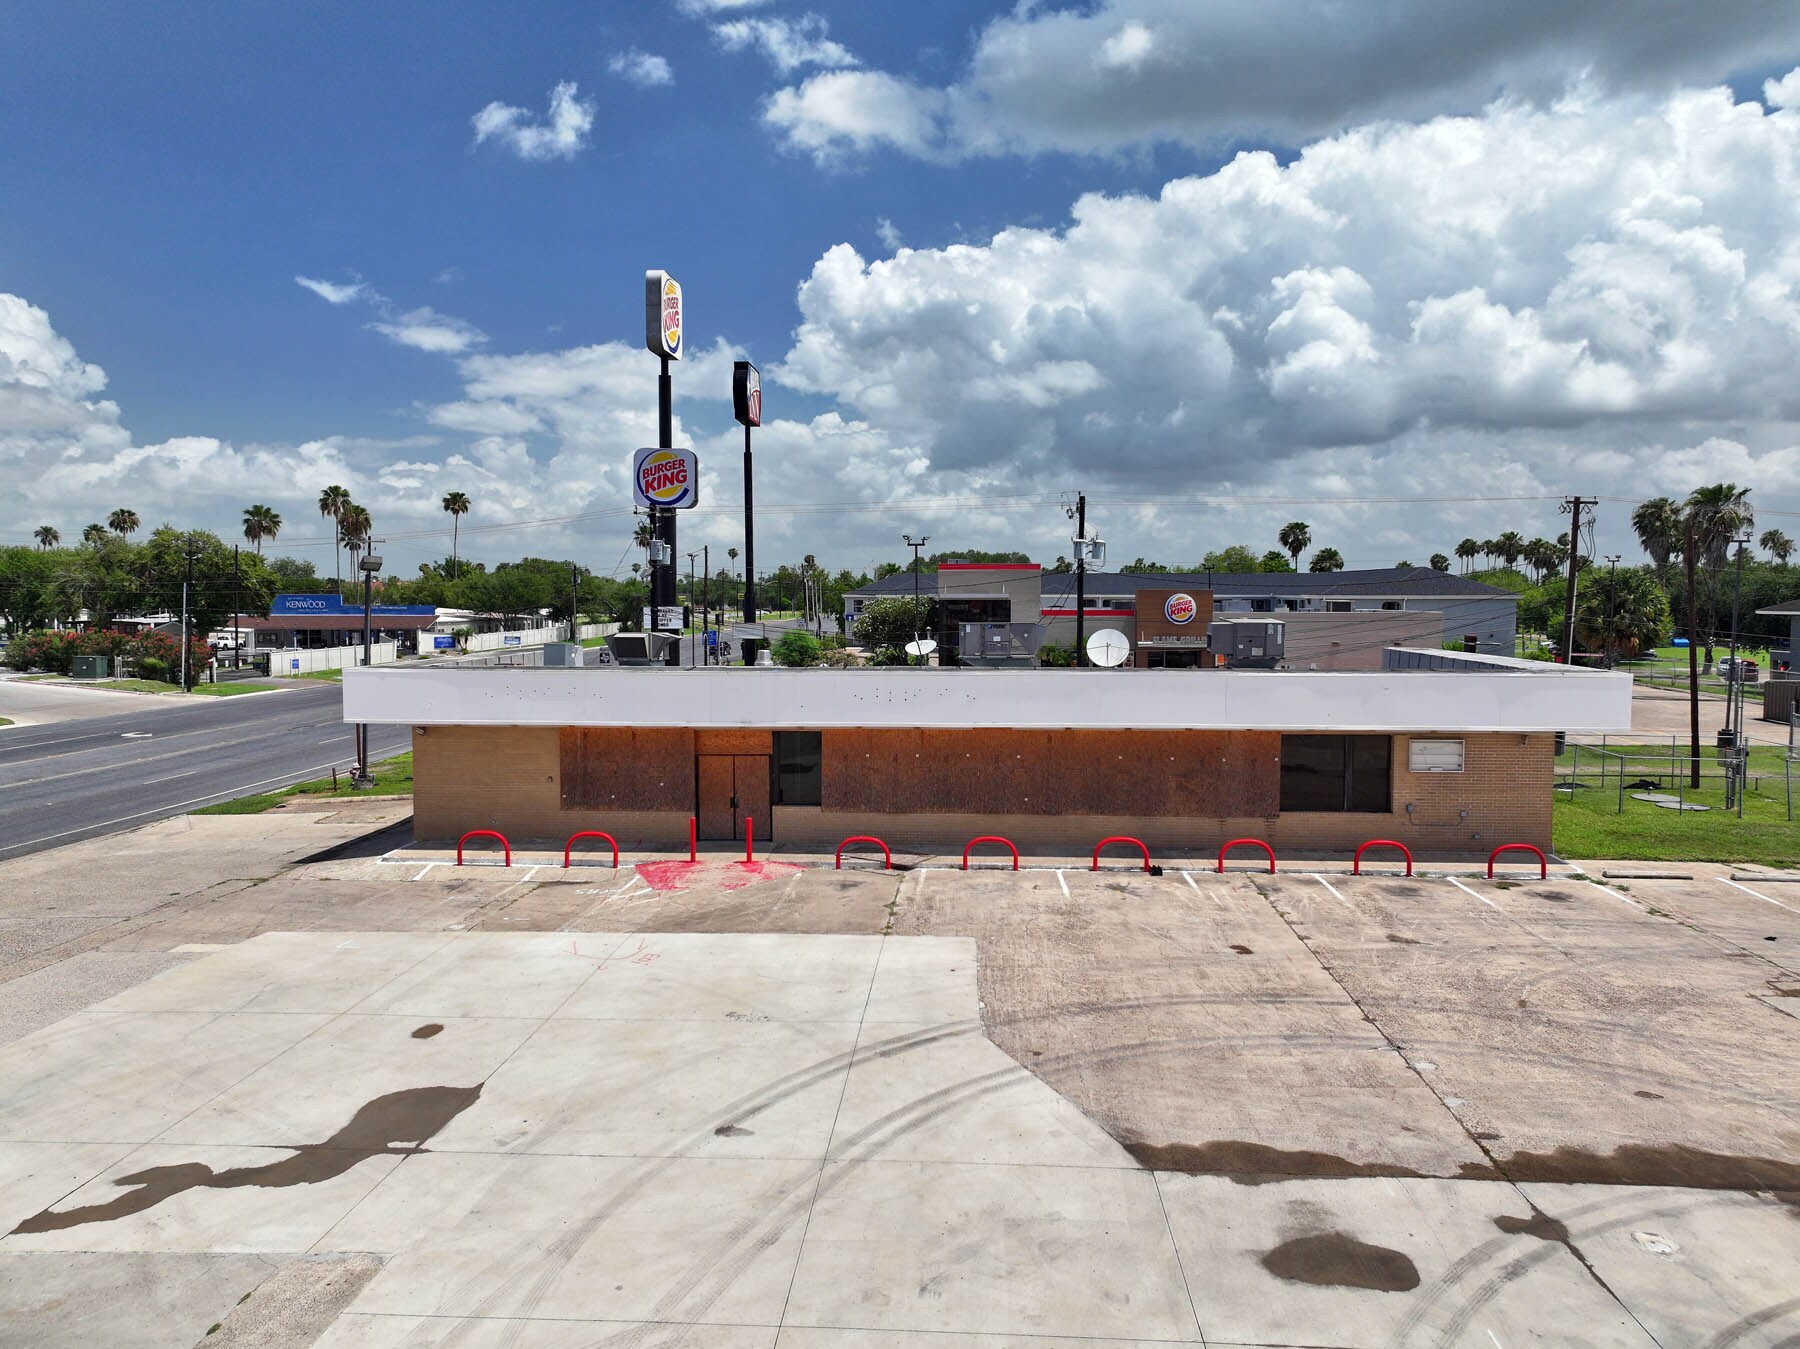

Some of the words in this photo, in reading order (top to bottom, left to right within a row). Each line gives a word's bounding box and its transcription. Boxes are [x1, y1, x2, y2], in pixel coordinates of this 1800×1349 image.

[664, 310, 680, 333] KING
[642, 458, 686, 480] BURGER
[644, 468, 688, 495] KING
[286, 600, 326, 609] KENWOOD
[1169, 599, 1193, 610] BURGER
[1170, 605, 1193, 617] KING
